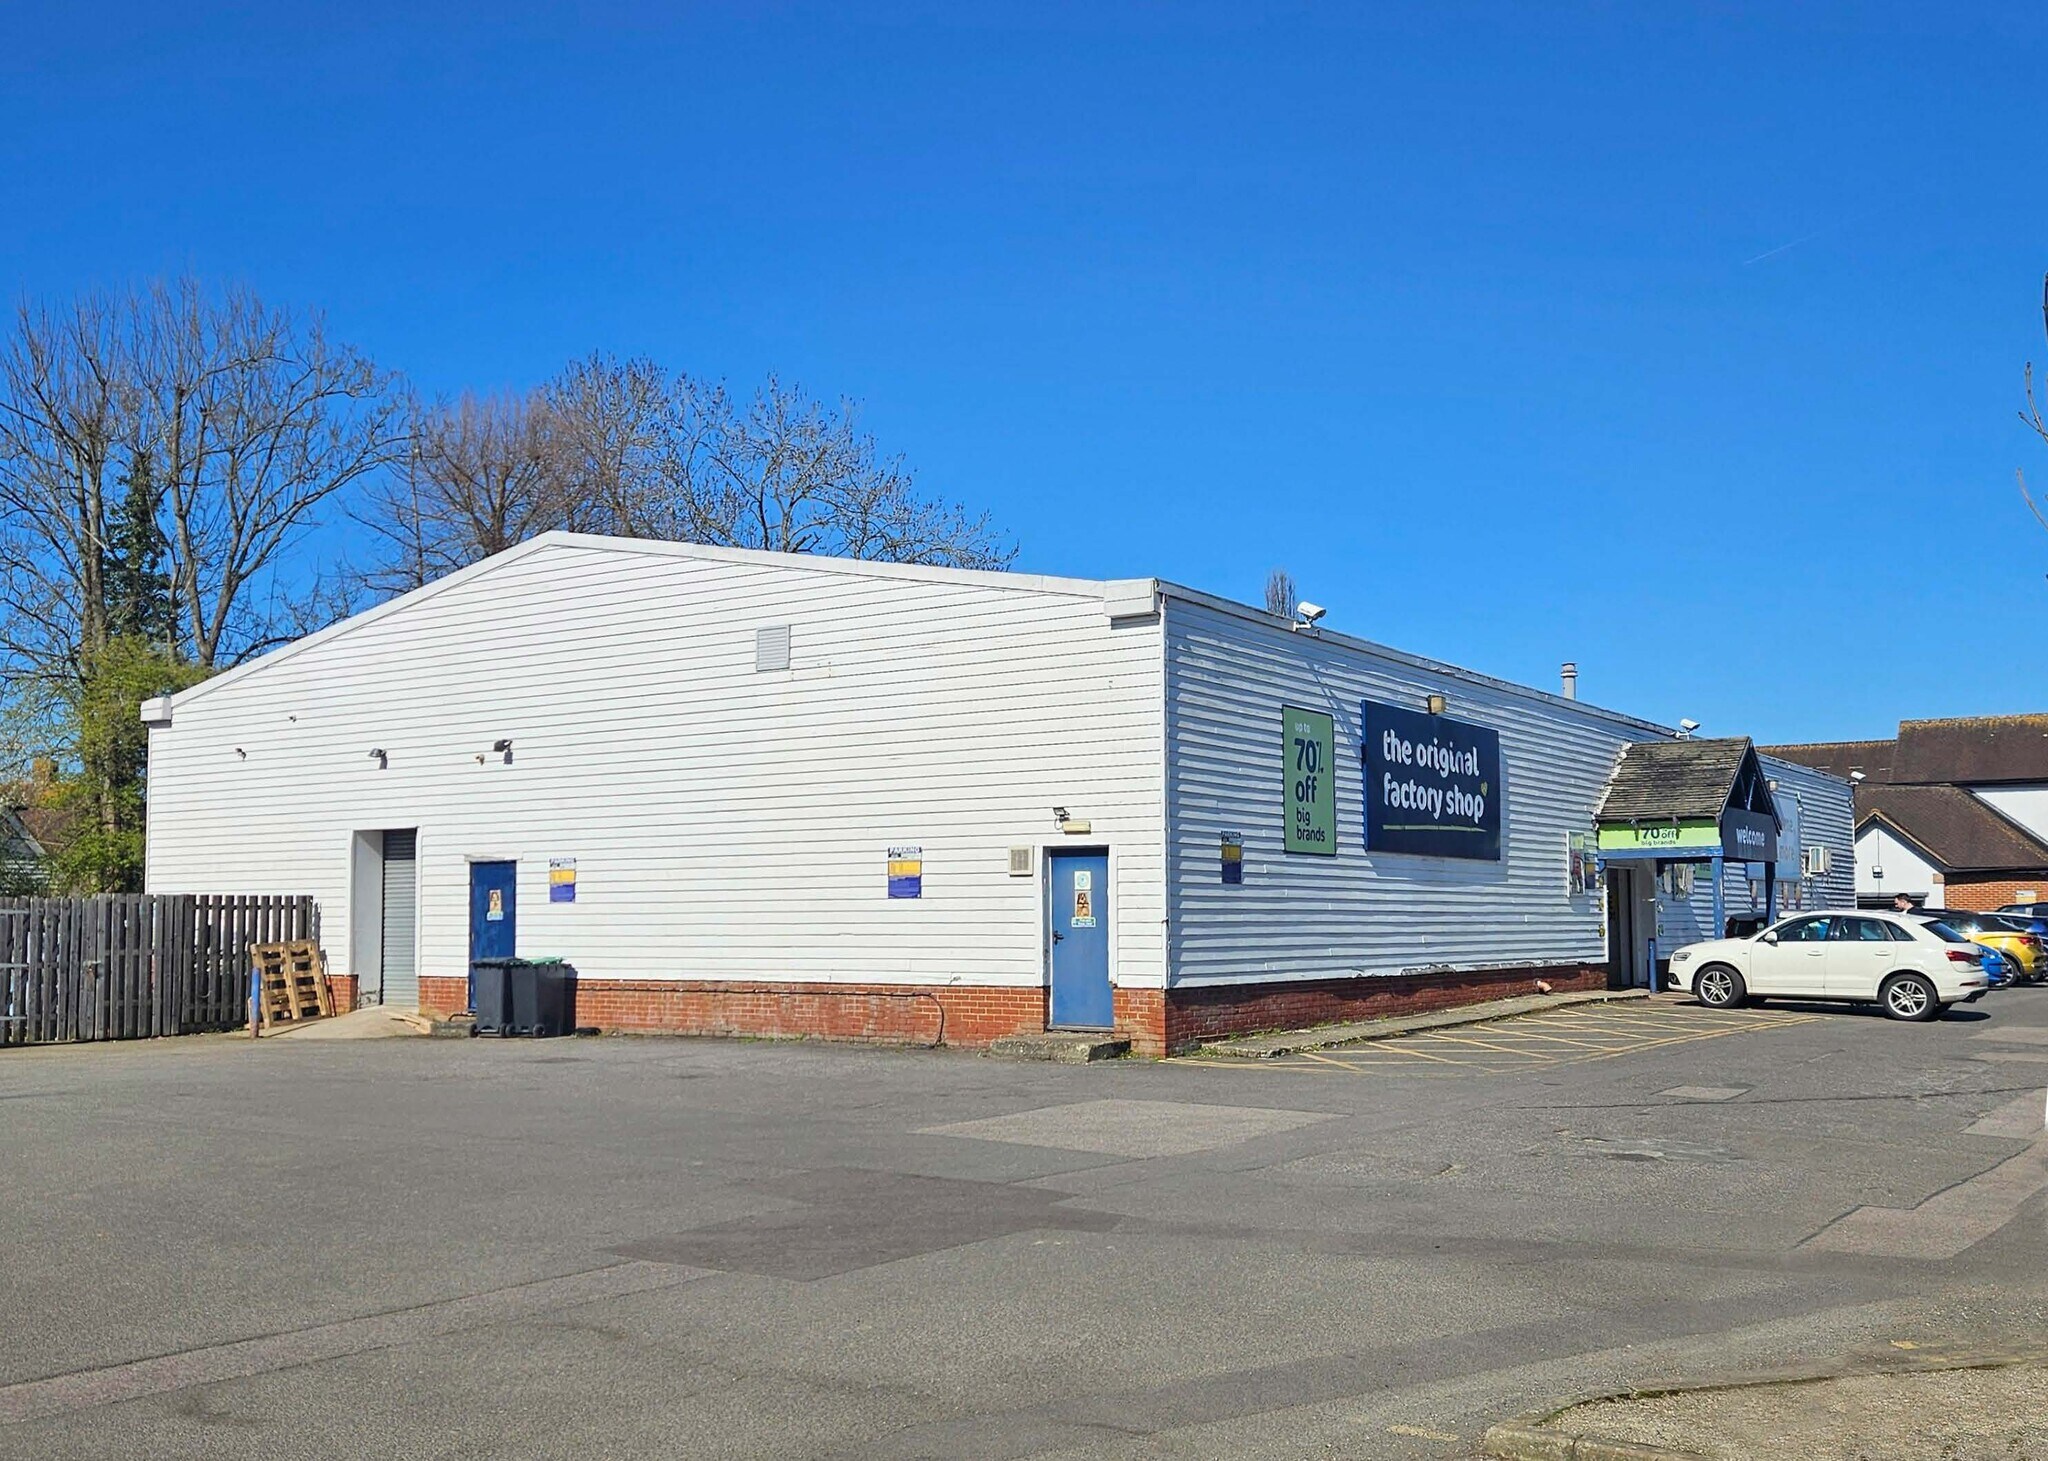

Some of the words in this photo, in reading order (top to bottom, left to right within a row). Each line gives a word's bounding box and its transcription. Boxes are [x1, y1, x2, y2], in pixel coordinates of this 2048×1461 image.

[1294, 737, 1324, 773] 70%
[1383, 728, 1412, 765] the
[1416, 737, 1479, 778] original
[1295, 775, 1317, 803] off
[1383, 771, 1443, 820] factory
[1446, 784, 1484, 824] shop
[1296, 807, 1310, 826] big
[1296, 824, 1326, 842] brands
[1661, 830, 1675, 839] off
[1736, 825, 1765, 847] welcome
